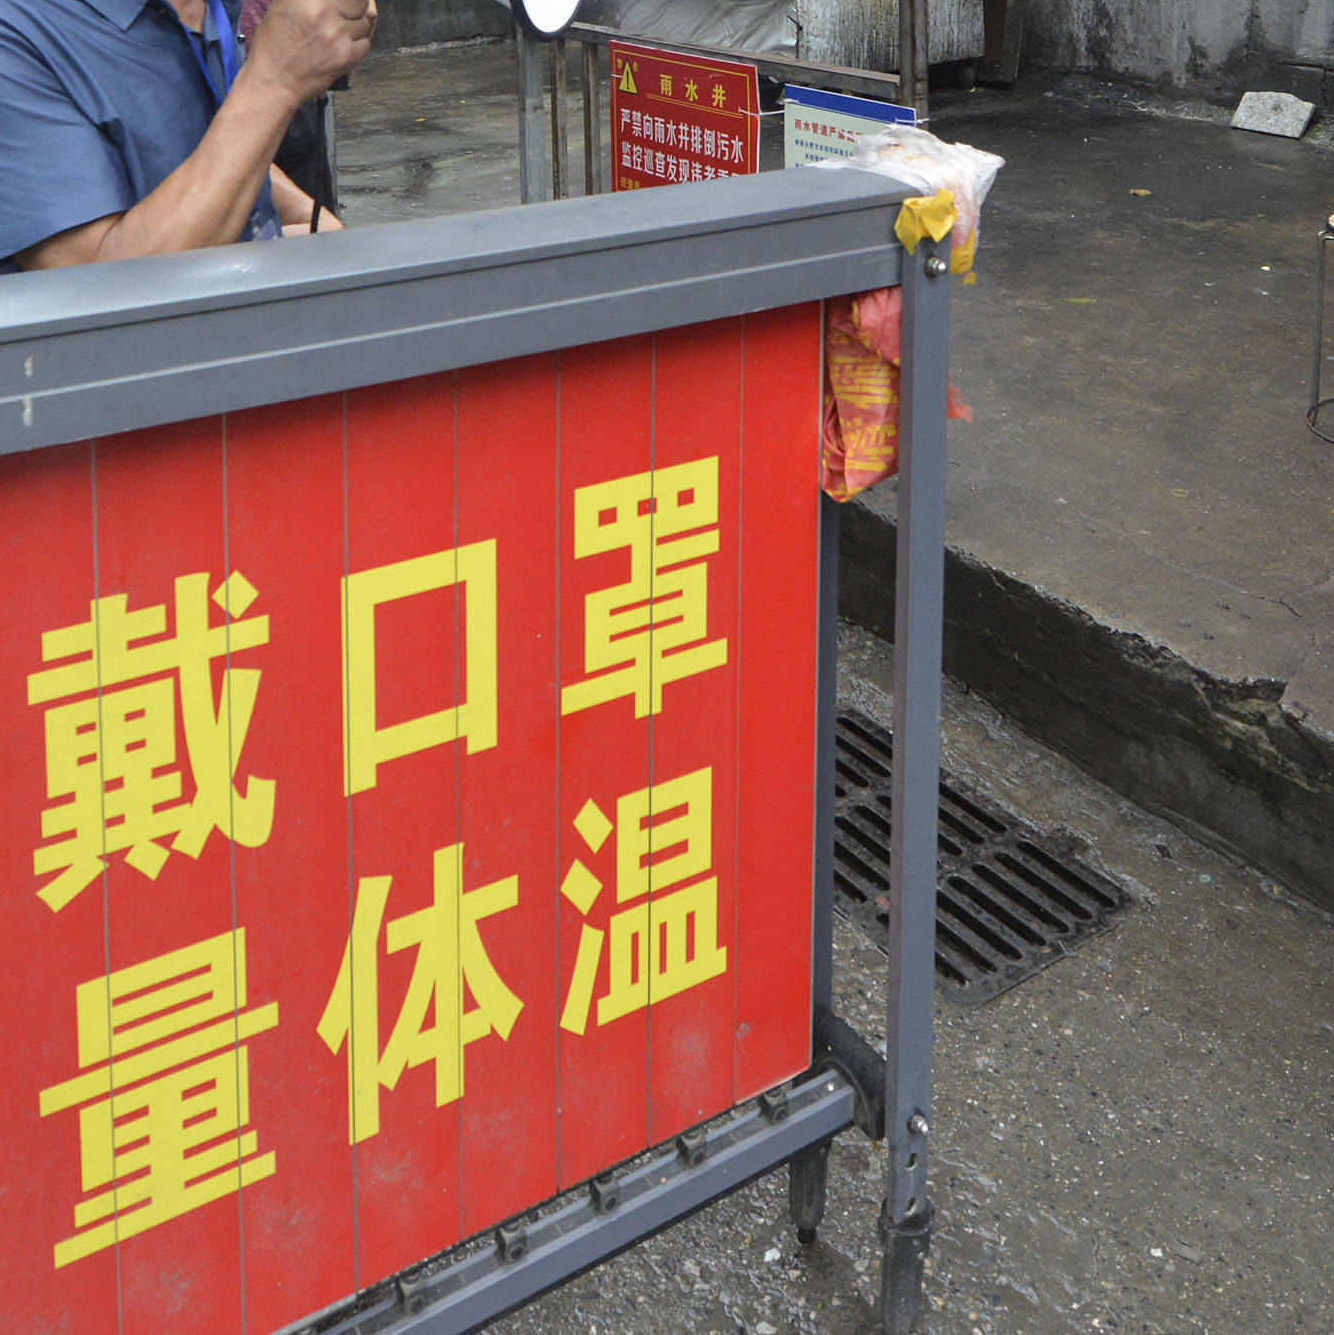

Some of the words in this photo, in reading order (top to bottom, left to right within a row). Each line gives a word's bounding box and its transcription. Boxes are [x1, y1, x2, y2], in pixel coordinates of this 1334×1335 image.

[659, 73, 727, 109] 雨水井
[620, 107, 744, 164] 严禁向雨水井排倒污水
